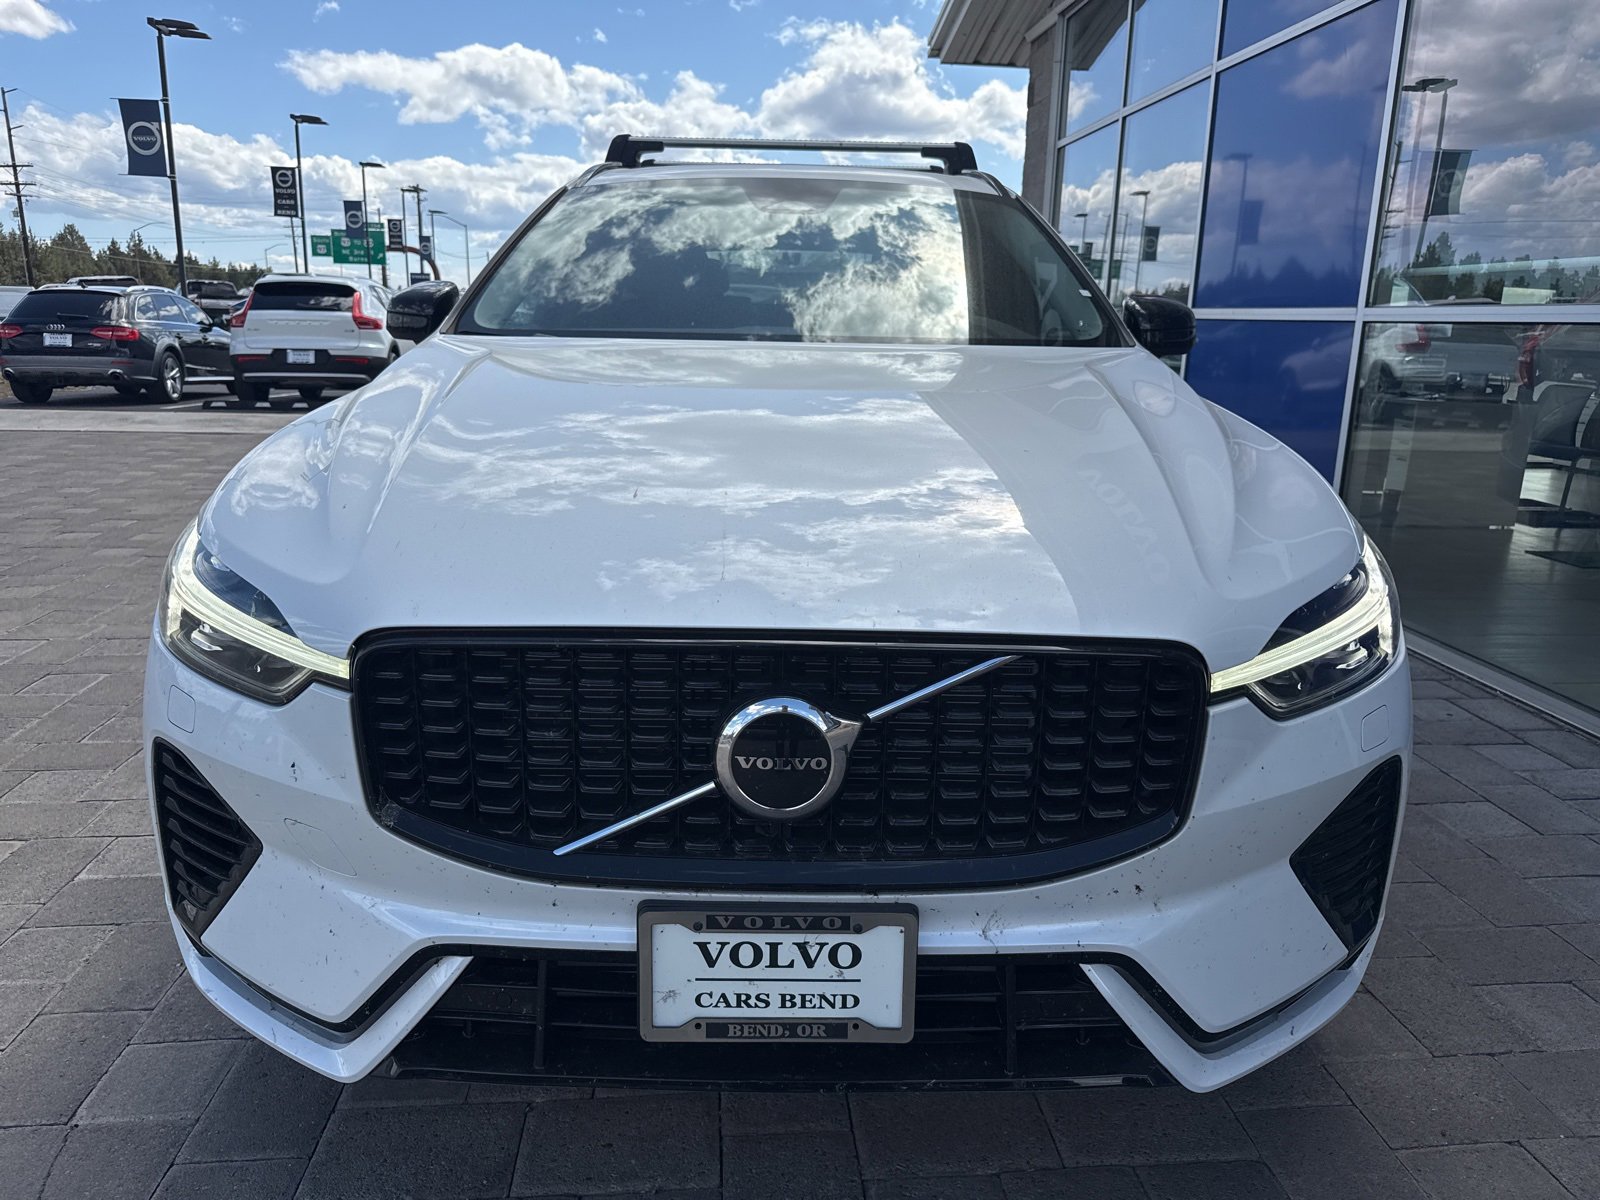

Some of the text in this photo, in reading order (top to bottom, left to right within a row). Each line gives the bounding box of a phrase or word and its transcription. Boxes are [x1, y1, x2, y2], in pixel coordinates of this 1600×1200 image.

[734, 755, 828, 770] VOLVO
[714, 915, 843, 930] VOLVO
[692, 941, 863, 970] VOLVO
[694, 992, 861, 1010] CARS BEND
[796, 1023, 828, 1038] OR
